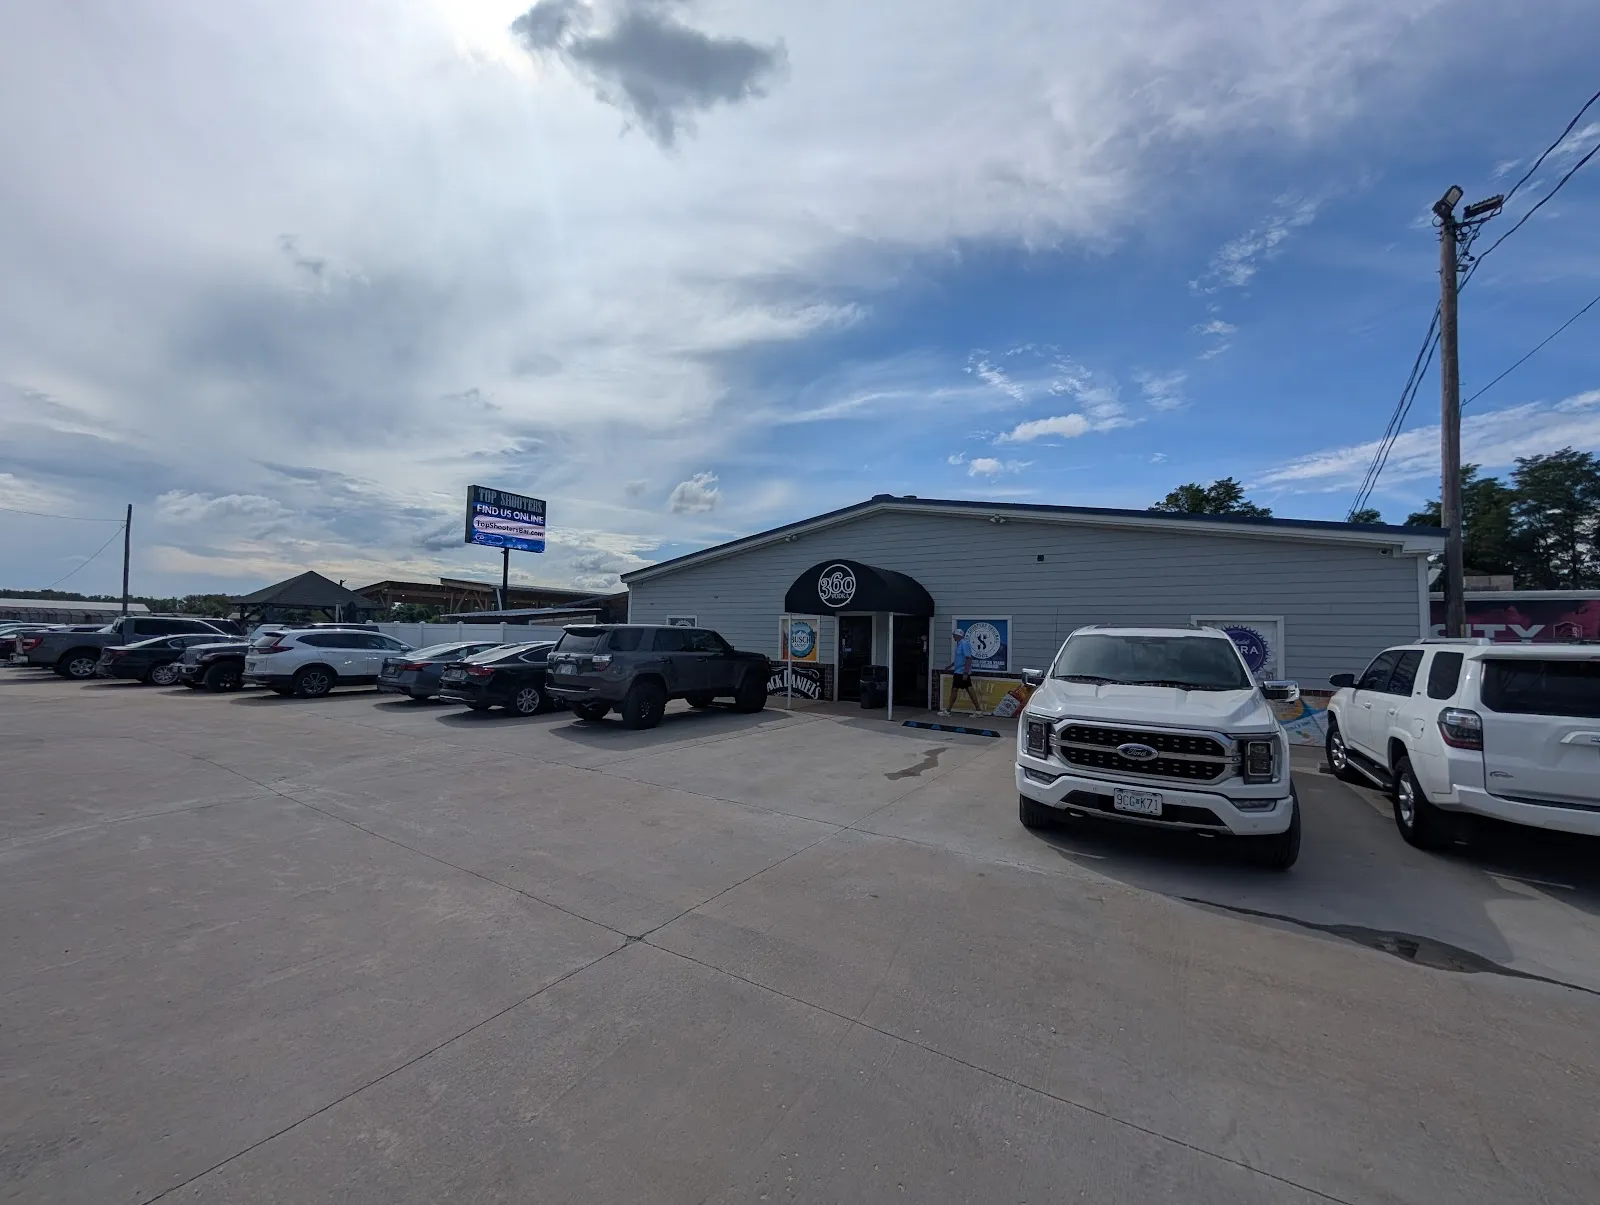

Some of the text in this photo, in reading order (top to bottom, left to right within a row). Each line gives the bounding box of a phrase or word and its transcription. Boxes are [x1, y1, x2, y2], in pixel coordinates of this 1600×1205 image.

[479, 488, 543, 513] TOP SHOOTERS
[476, 504, 544, 524] FIND US ONLINE
[476, 519, 544, 537] TopShootersBar.com
[819, 571, 855, 600] 360
[790, 636, 811, 645] BUSCH
[766, 669, 822, 700] ACK DANIEL'S
[1126, 747, 1147, 757] Ford
[1140, 797, 1158, 811] K71
